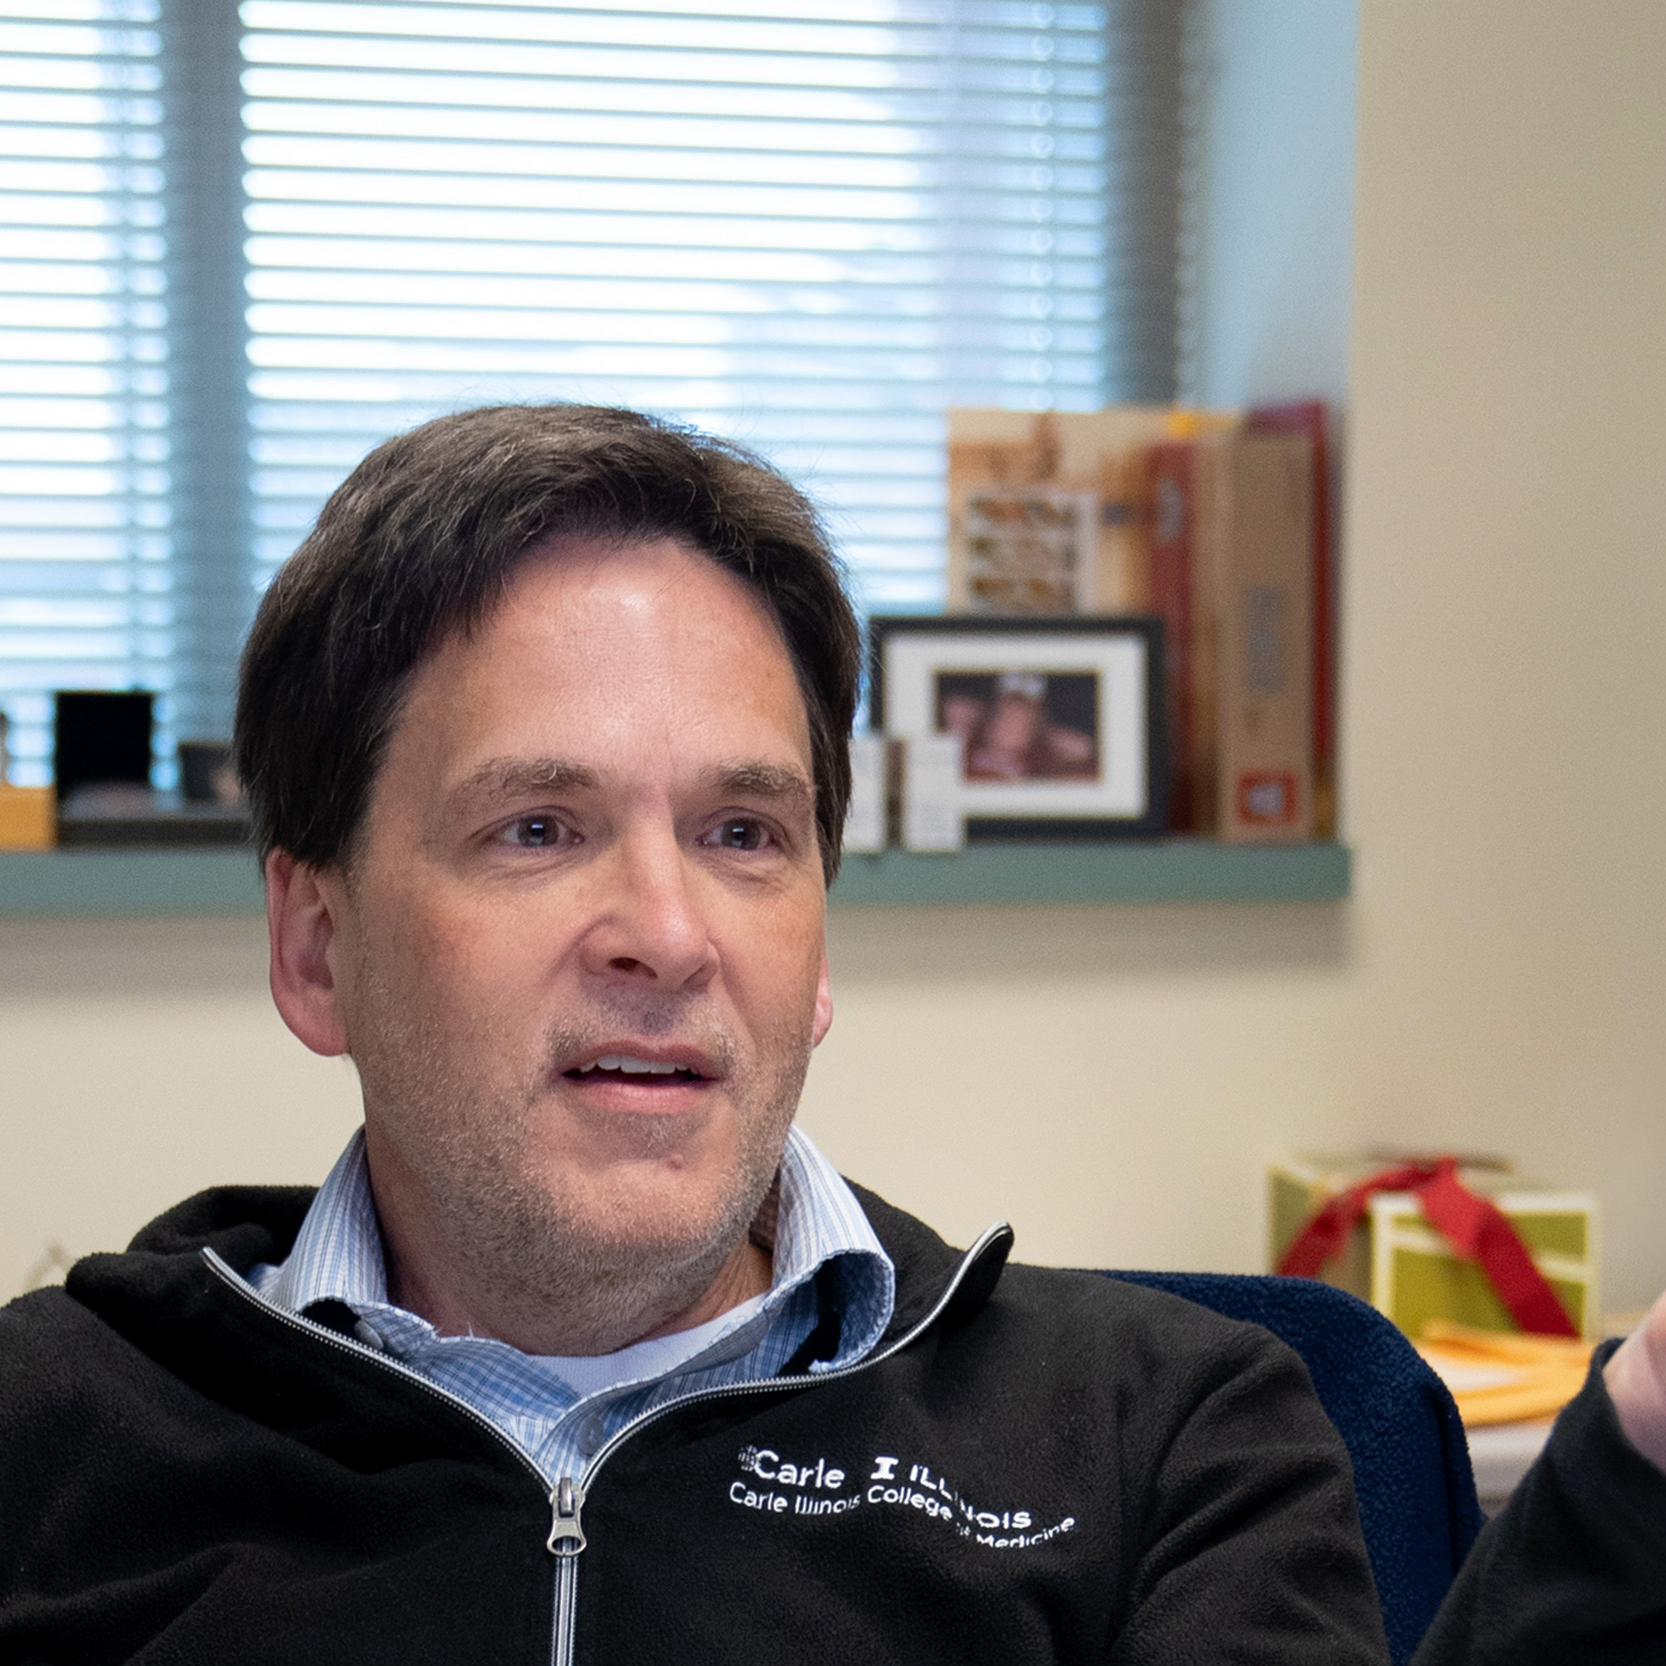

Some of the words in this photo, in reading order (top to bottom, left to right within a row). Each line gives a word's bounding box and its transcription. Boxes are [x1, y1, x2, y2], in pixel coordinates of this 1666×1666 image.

[754, 1450, 845, 1489] Carle
[729, 1482, 789, 1513] Carle
[795, 1493, 861, 1516] Illinois
[867, 1485, 953, 1522] College
